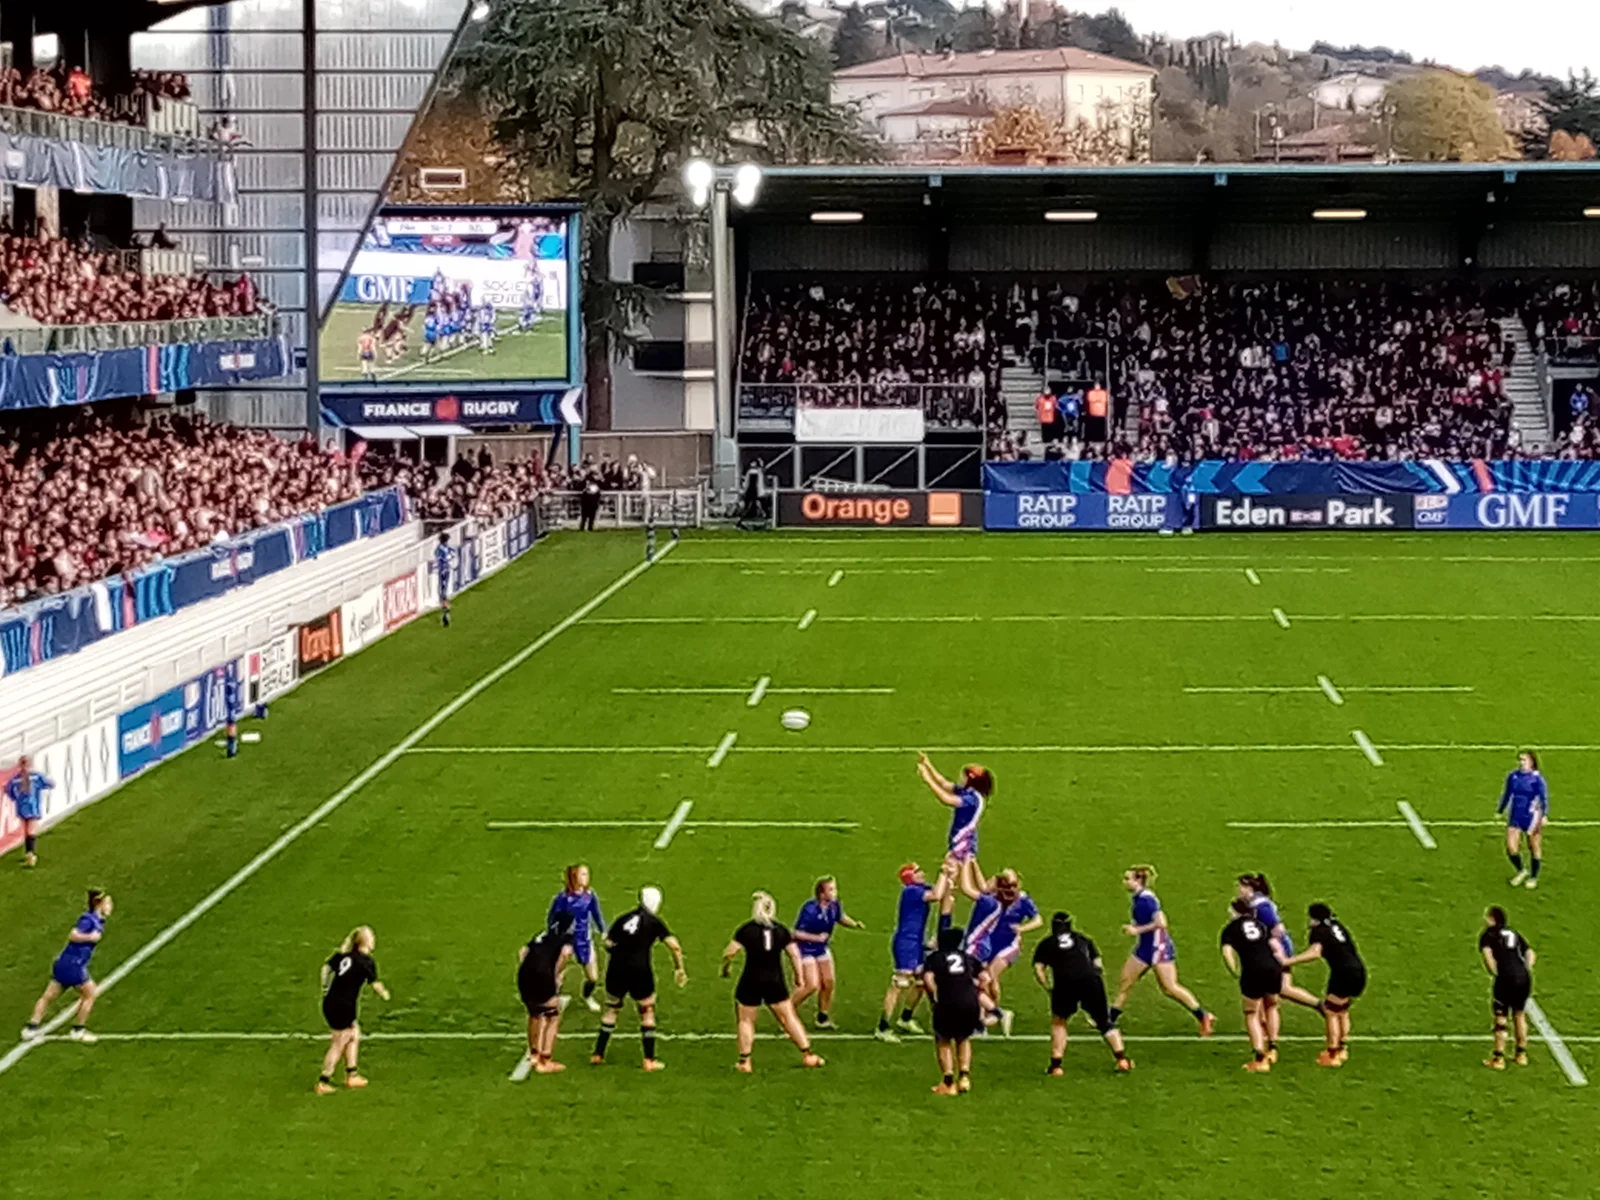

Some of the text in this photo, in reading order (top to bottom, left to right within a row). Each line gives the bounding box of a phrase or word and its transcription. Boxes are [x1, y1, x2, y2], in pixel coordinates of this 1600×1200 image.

[357, 275, 414, 302] GMF
[363, 401, 520, 417] FRANCE RUGBY
[802, 493, 911, 524] Orange
[1018, 495, 1077, 513] RATP
[1108, 495, 1167, 513] RATP
[1215, 501, 1286, 526] Eden
[1326, 499, 1394, 526] Park
[1478, 494, 1570, 528] GMF
[1018, 513, 1076, 528] GROUP
[1107, 513, 1165, 528] GROUP
[623, 914, 640, 934] 4
[1243, 920, 1261, 940] 5
[763, 930, 771, 951] 1
[1501, 930, 1516, 948] 7
[338, 955, 352, 976] 9
[947, 954, 964, 973] 2
